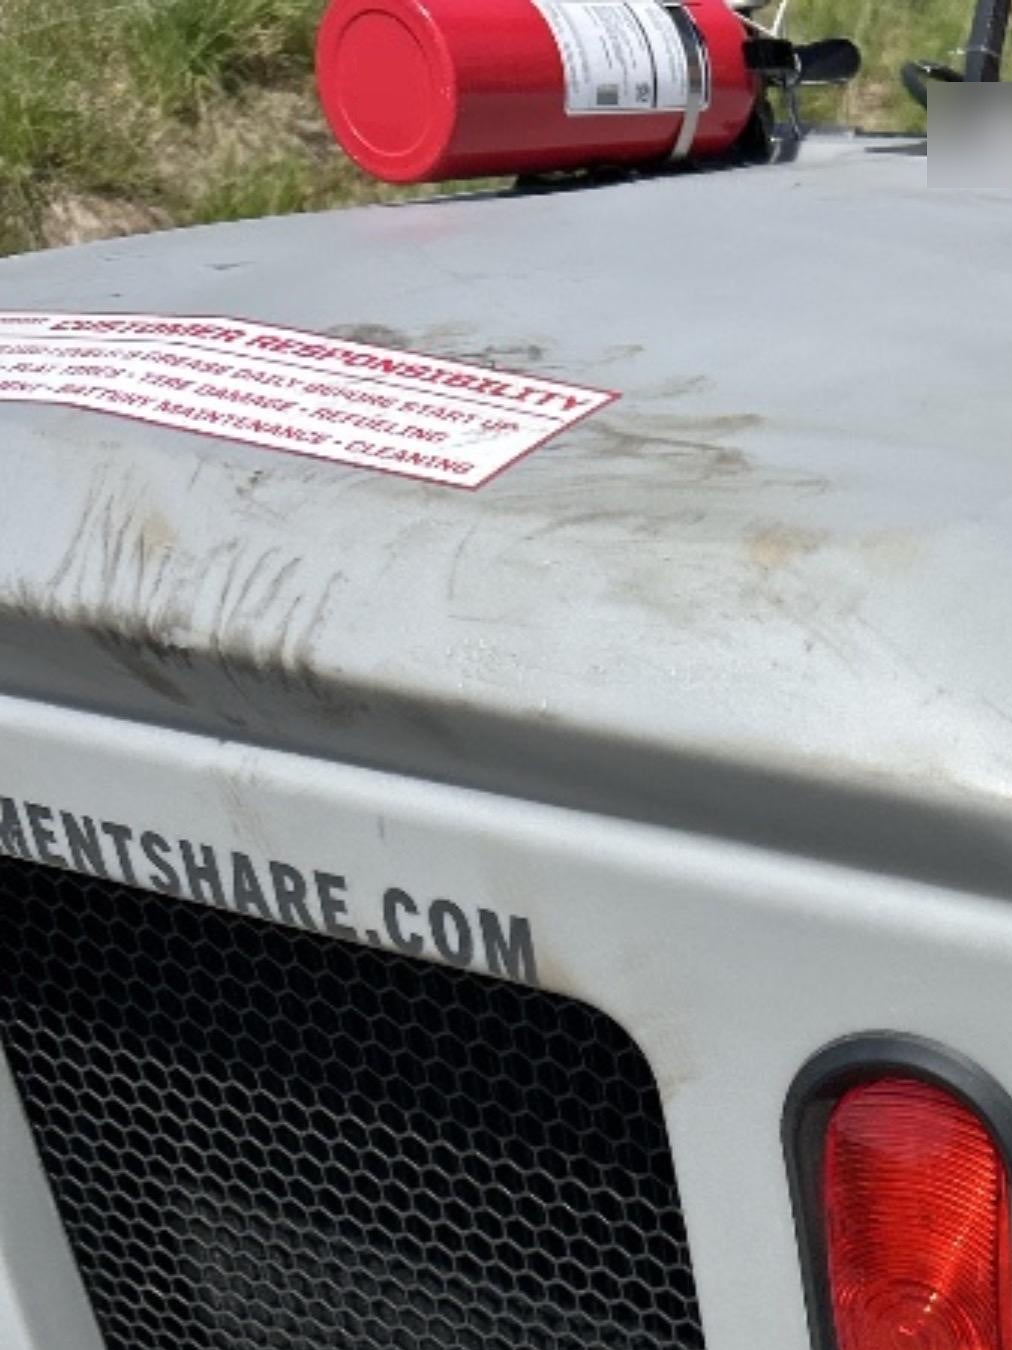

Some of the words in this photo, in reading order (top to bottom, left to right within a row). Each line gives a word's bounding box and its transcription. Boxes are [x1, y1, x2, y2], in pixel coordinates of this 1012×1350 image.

[244, 335, 592, 411] RESPONSIBILITY
[151, 399, 333, 445] MAINTENANCE
[344, 440, 475, 474] CLEANING
[193, 383, 299, 412] DAMAGE
[308, 407, 449, 443] REFUELING
[397, 401, 476, 424] START
